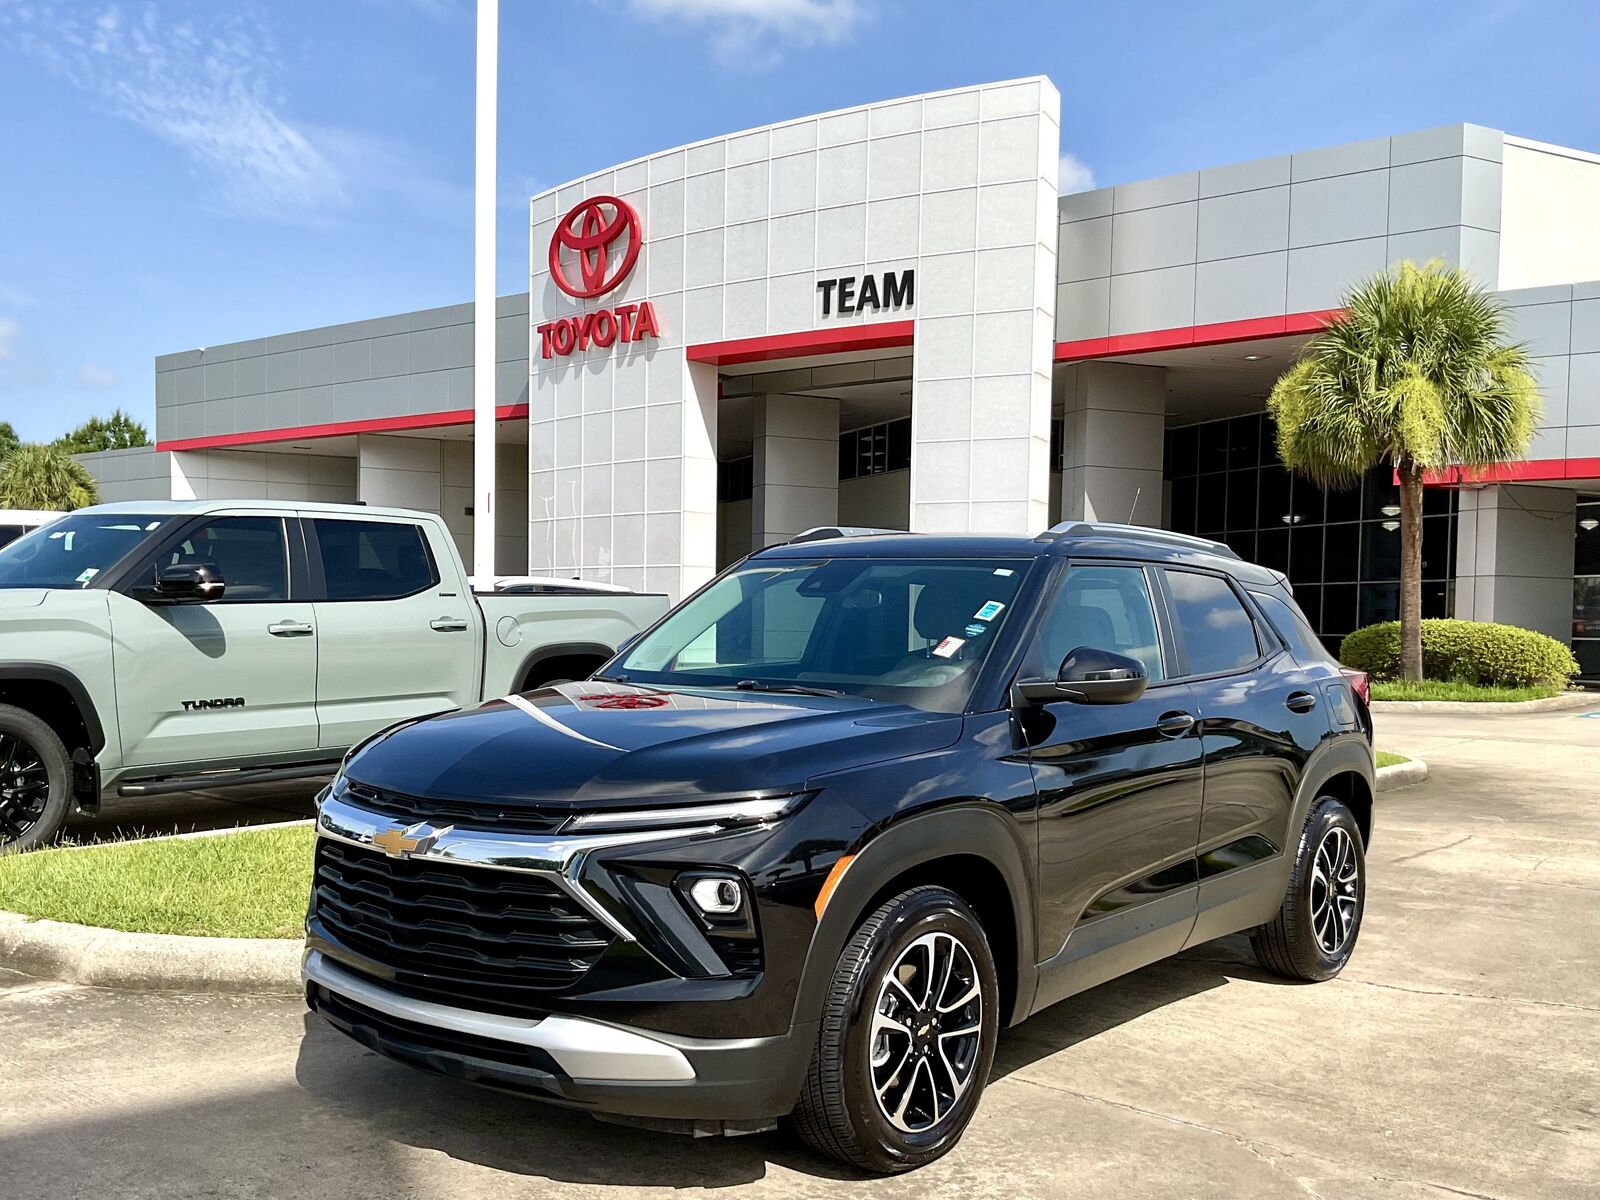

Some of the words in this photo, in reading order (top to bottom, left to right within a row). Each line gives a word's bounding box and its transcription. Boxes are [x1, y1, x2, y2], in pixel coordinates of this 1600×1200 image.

[816, 270, 915, 315] TEAM
[537, 301, 659, 359] TOYOTA
[181, 697, 245, 711] TUNDRA
